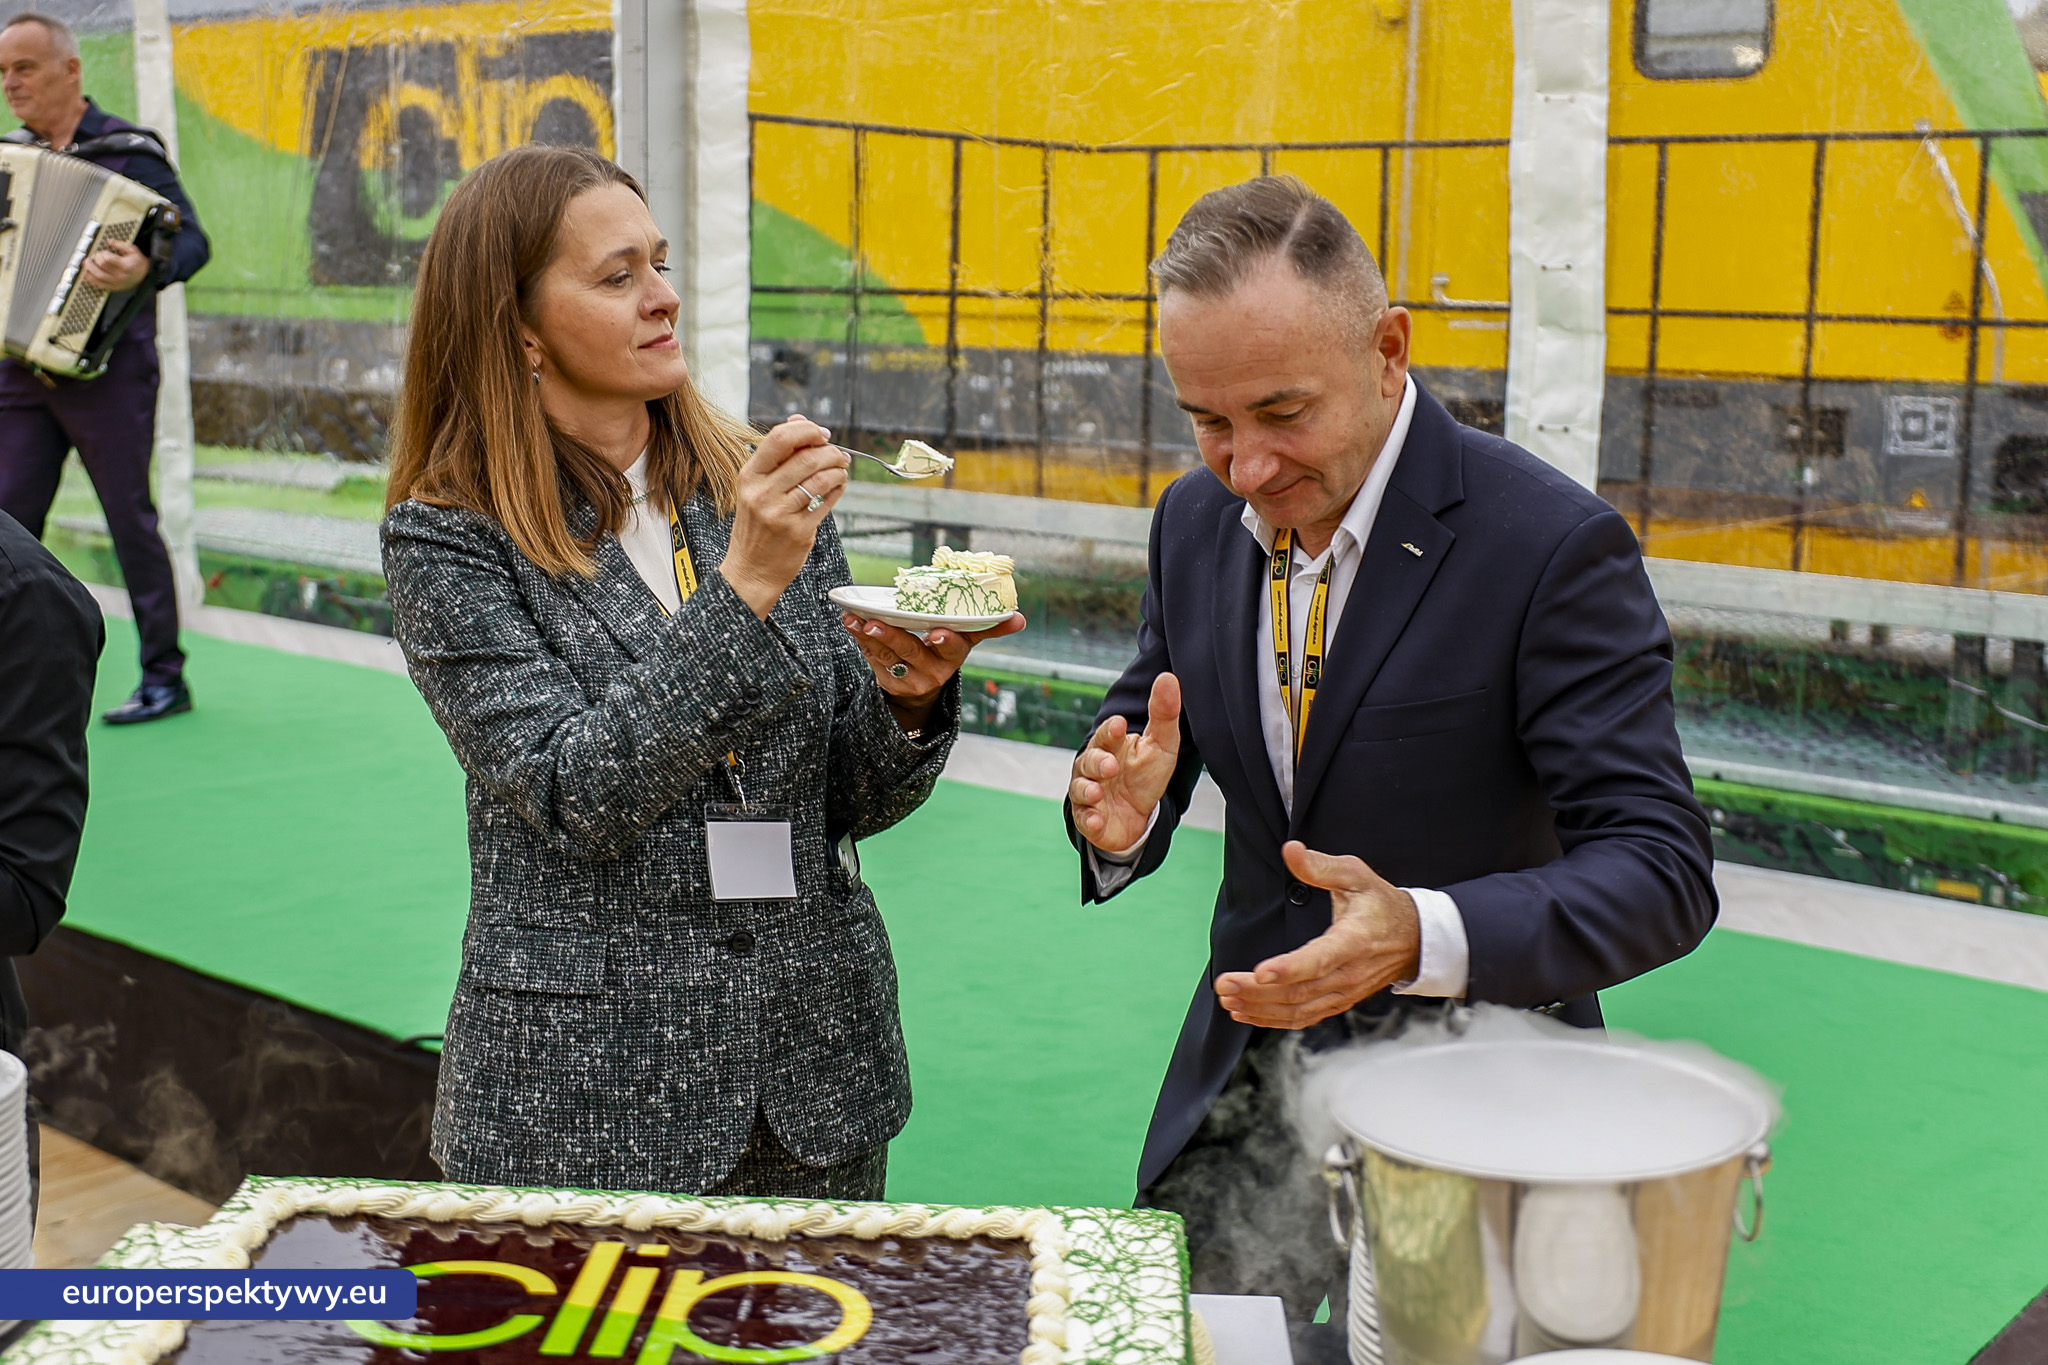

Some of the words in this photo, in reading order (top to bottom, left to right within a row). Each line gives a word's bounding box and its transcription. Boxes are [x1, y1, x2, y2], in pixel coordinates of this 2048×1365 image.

[1273, 553, 1287, 576] clip
[1278, 656, 1288, 681] clip
[1304, 660, 1320, 684] clip
